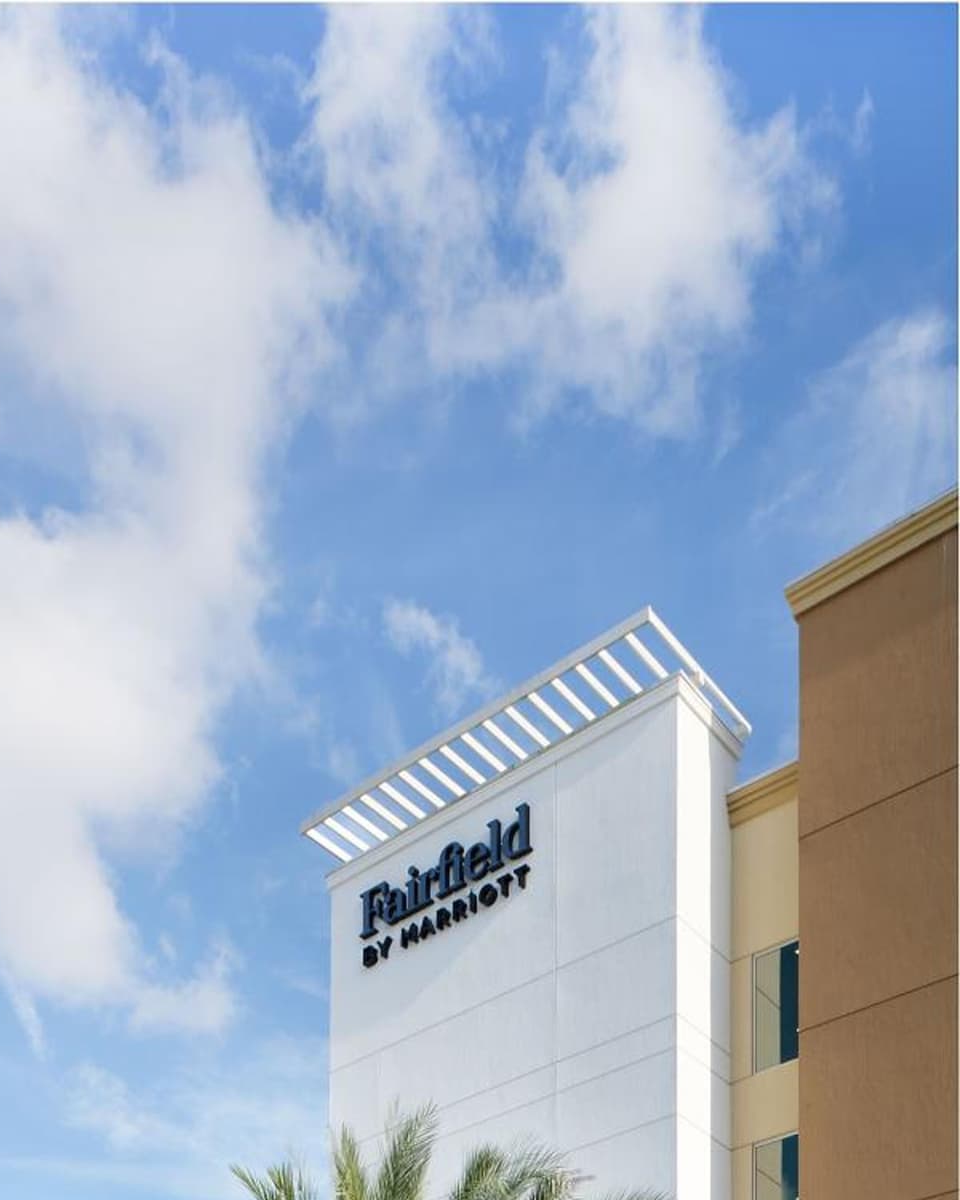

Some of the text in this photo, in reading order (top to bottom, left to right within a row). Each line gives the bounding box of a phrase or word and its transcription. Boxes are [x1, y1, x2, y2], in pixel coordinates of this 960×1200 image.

[360, 802, 533, 939] Fairfield
[363, 864, 531, 968] BY MARRIOTT
